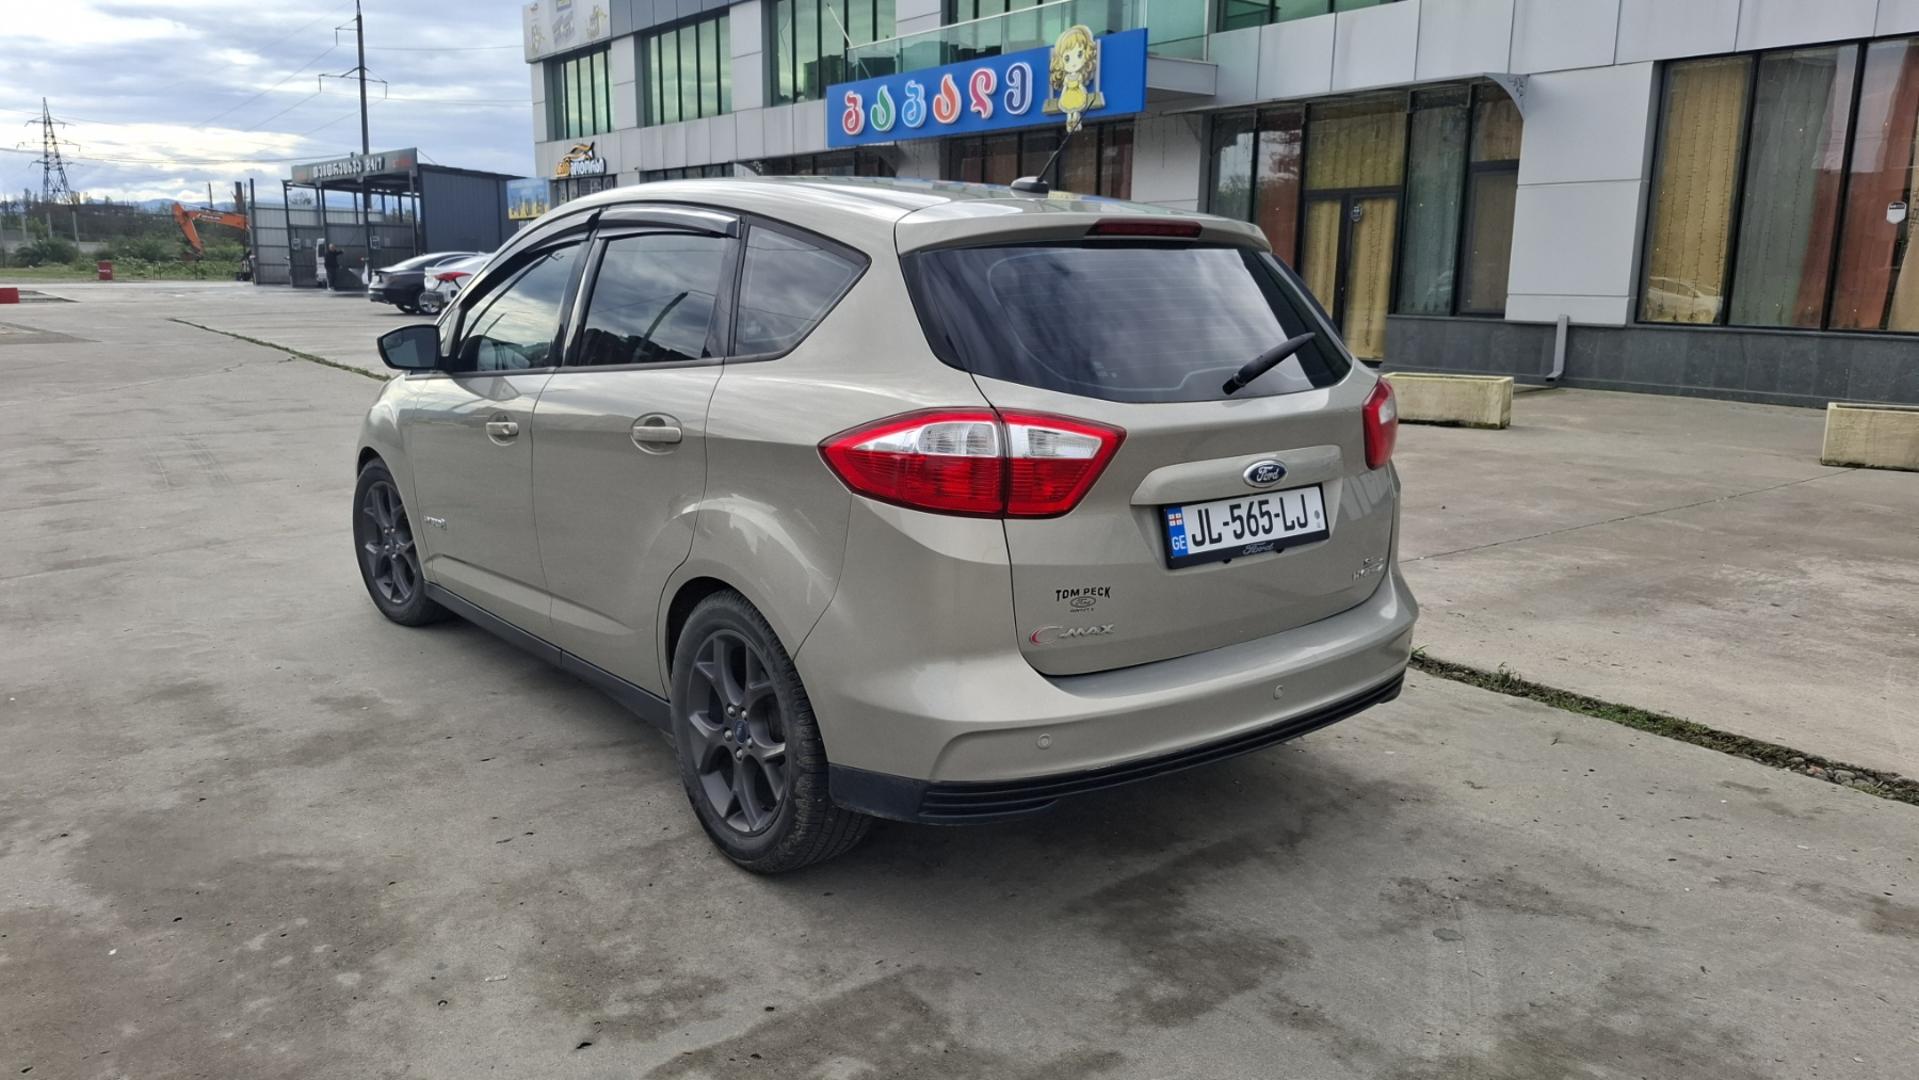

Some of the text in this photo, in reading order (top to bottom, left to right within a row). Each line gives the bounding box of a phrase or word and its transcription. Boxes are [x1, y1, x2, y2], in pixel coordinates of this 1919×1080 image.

[842, 62, 1033, 135] ბაბალე
[366, 157, 382, 171] 24/7
[1256, 466, 1280, 482] Ford
[1191, 493, 1309, 547] JL-565-LJ
[1172, 534, 1187, 551] GE
[1242, 542, 1275, 556] Ford
[1055, 588, 1080, 602] TOM
[1083, 586, 1111, 599] PECK
